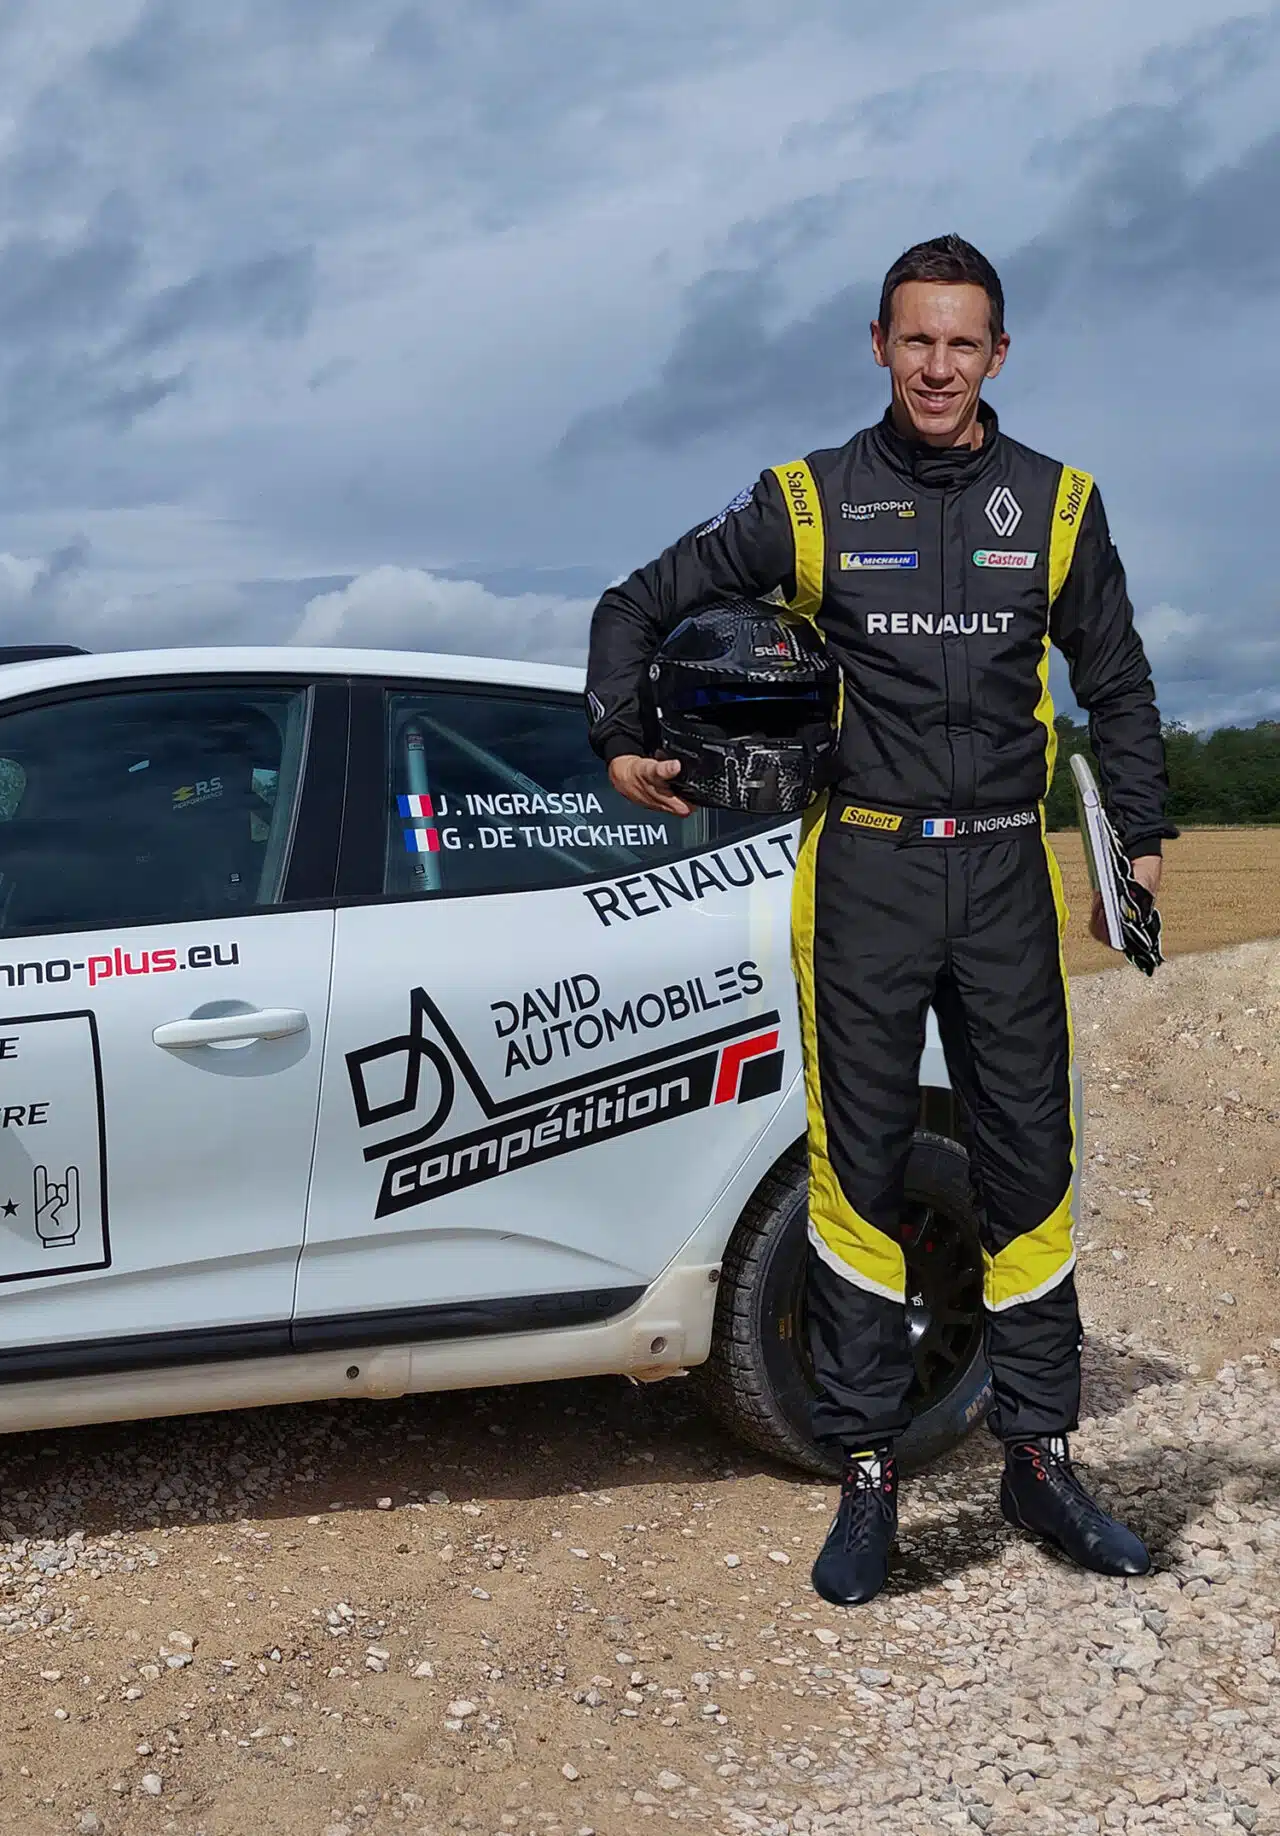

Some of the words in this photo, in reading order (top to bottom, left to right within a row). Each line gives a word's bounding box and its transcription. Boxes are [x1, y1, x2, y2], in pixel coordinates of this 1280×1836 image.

[786, 471, 815, 527] Sabelt
[1059, 474, 1086, 526] Sabelt
[862, 557, 911, 565] MICHELIN
[987, 553, 1028, 566] Castrol
[867, 612, 1014, 635] RENAULT
[469, 793, 603, 815] INGRASSIA
[847, 809, 896, 828] Sabelt
[957, 821, 969, 834] J.
[973, 811, 1037, 833] INGRASSIA
[479, 827, 516, 849] DE
[519, 824, 668, 848] TURCKHEIM
[583, 833, 796, 927] RENAULT
[490, 973, 601, 1039] DAVID
[504, 960, 764, 1078] AUTOMOBILES
[390, 1075, 690, 1197] compétition
